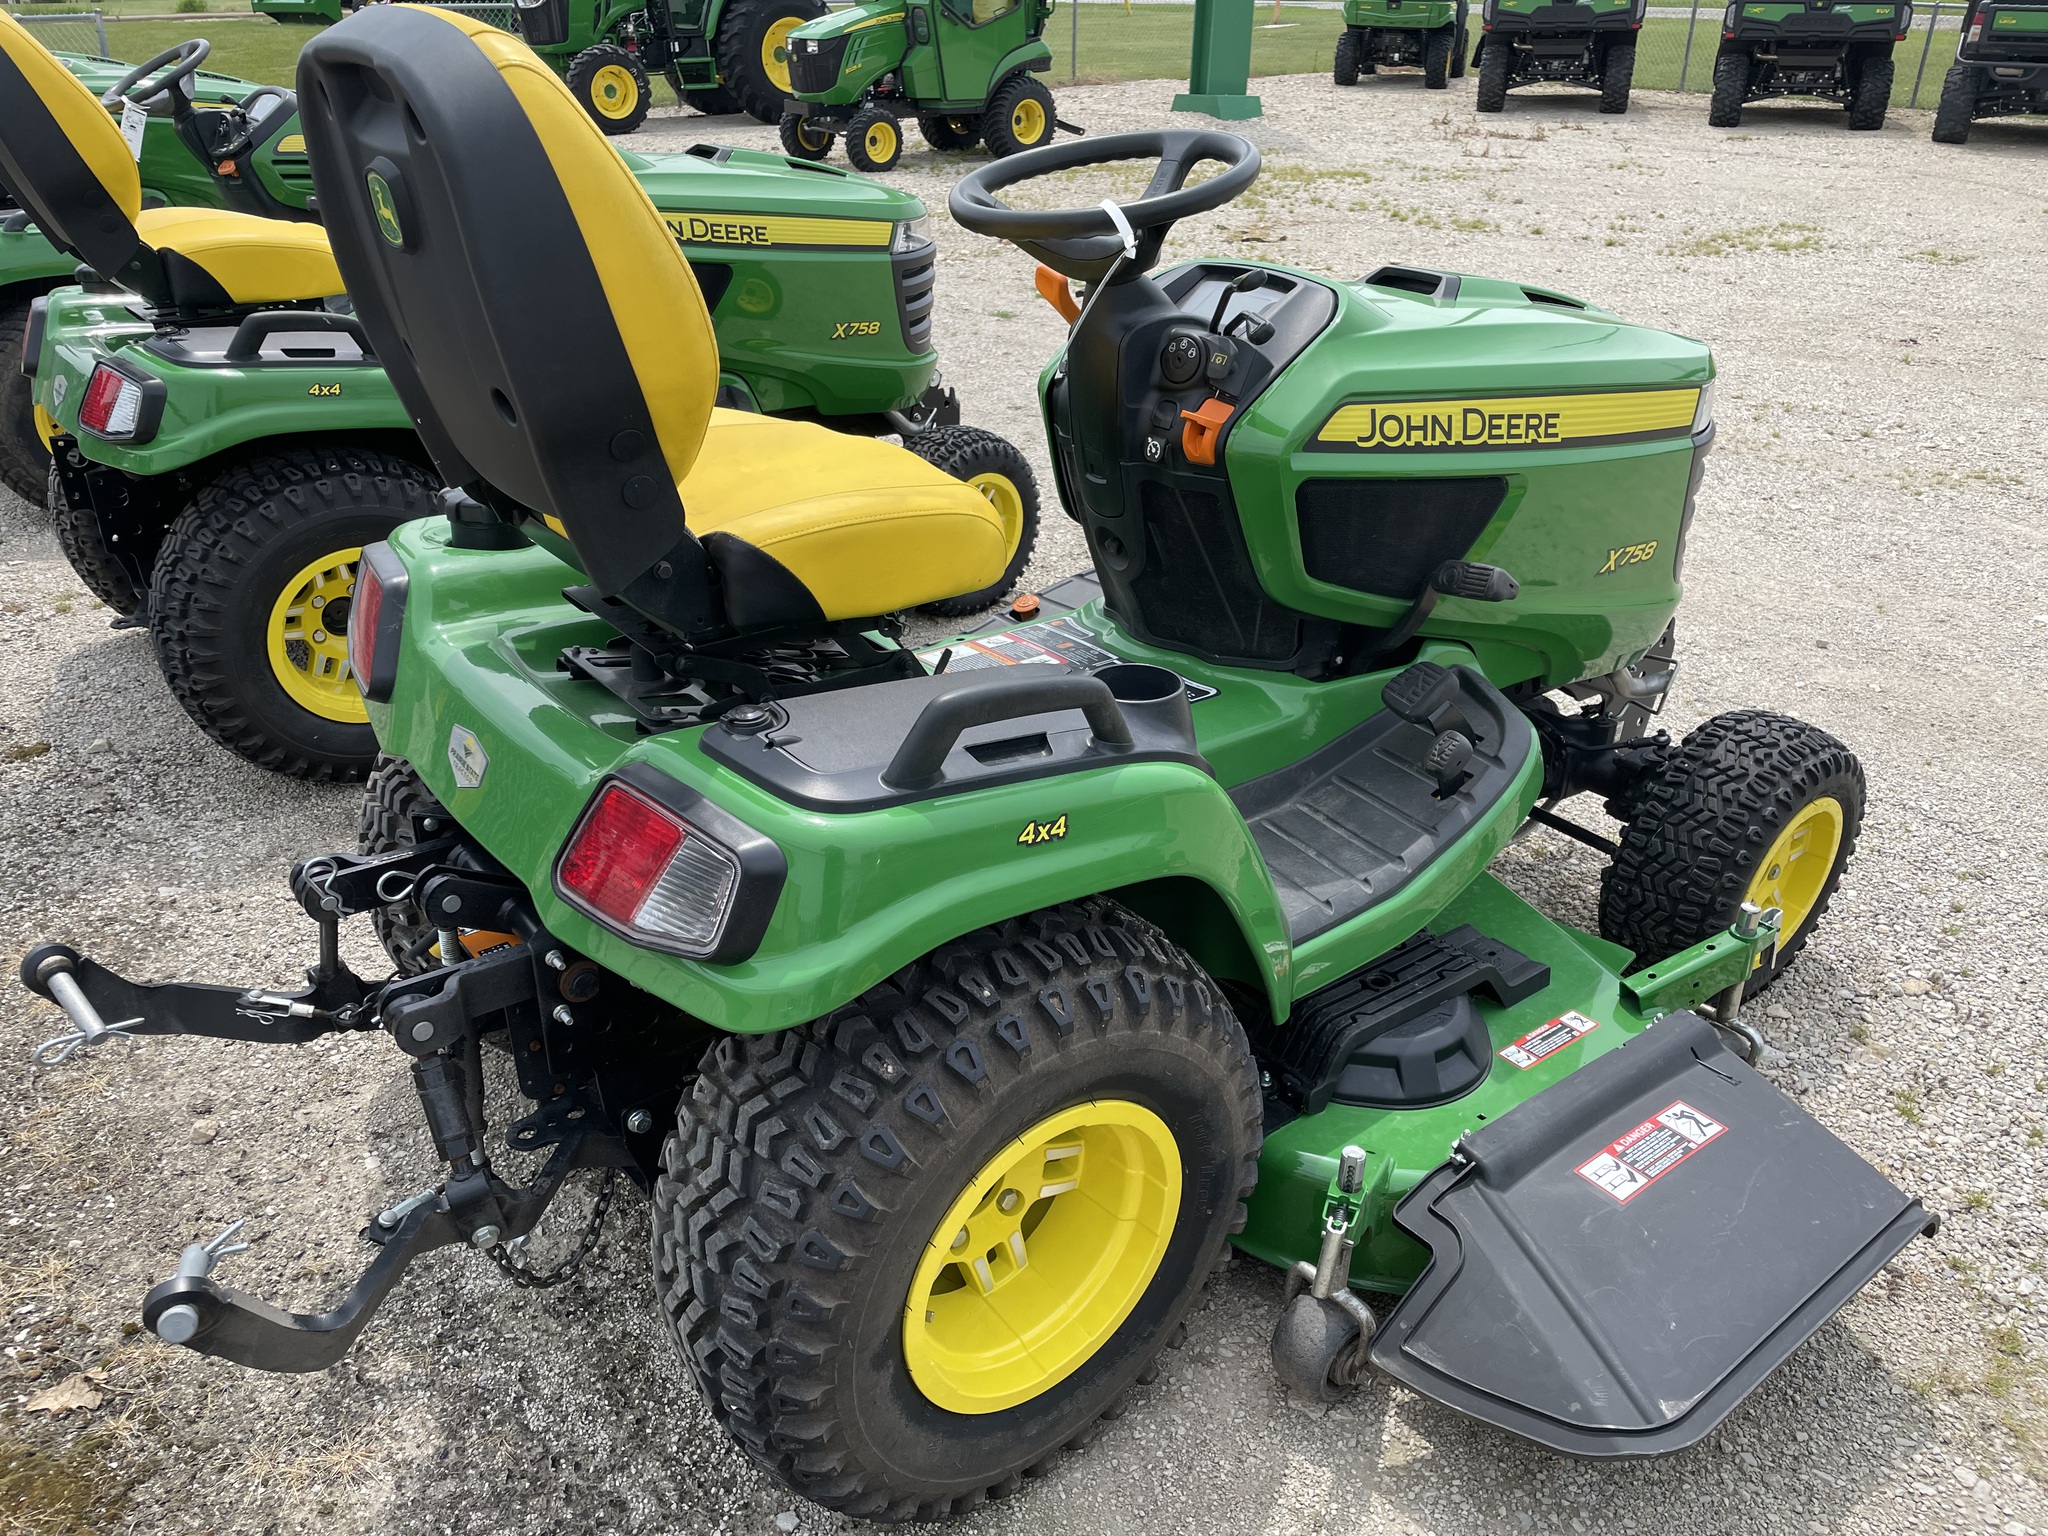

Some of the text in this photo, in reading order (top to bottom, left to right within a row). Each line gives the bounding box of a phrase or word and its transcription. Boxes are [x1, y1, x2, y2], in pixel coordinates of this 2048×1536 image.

[689, 218, 770, 244] DEERE
[831, 321, 881, 341] X758
[308, 382, 341, 396] 4x4
[1357, 407, 1561, 444] JOHN DEERE
[1598, 540, 1658, 574] X758
[466, 763, 480, 782] STATE
[1018, 814, 1067, 845] 4x4
[1619, 1122, 1656, 1147] DANGER
